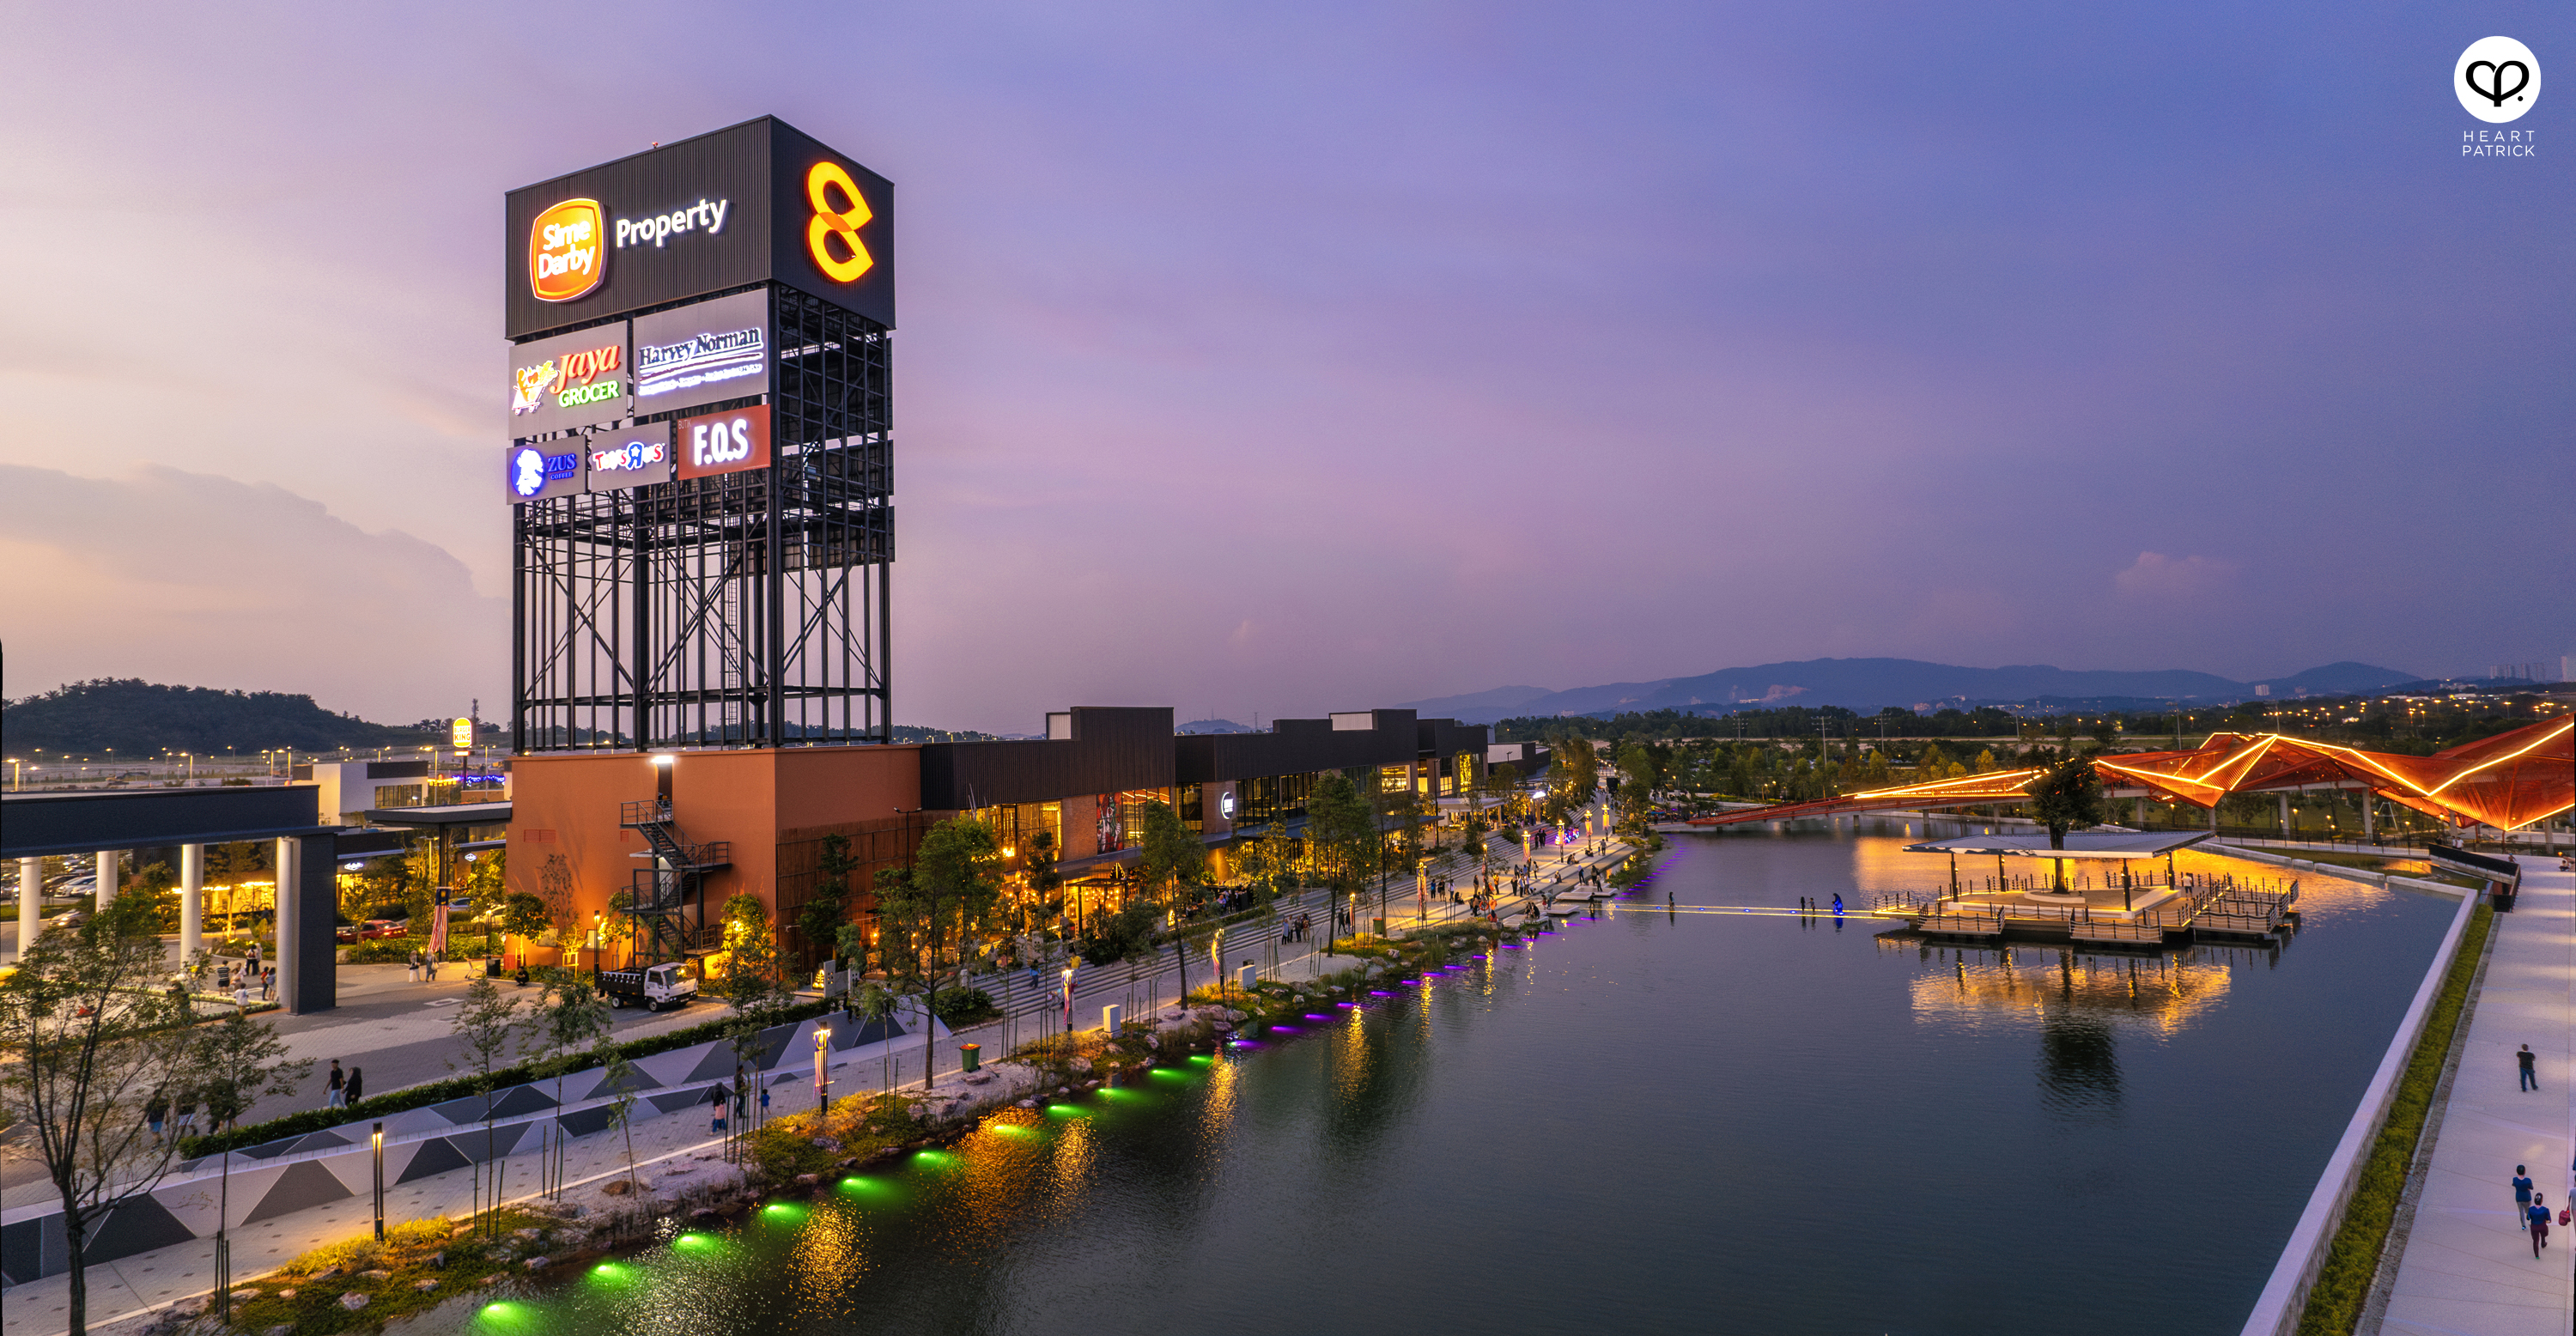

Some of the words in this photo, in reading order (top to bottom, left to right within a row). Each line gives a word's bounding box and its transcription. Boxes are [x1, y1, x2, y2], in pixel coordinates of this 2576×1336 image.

[543, 221, 591, 251] Sime
[617, 198, 727, 247] Property
[538, 244, 595, 279] Darby
[639, 341, 696, 367] Harvey
[696, 327, 761, 354] Norman
[550, 345, 620, 395] Jaya
[558, 380, 620, 408] GROCER
[678, 418, 692, 429] BUTIK
[548, 452, 576, 472] ZUS
[550, 471, 574, 480] COFFEE
